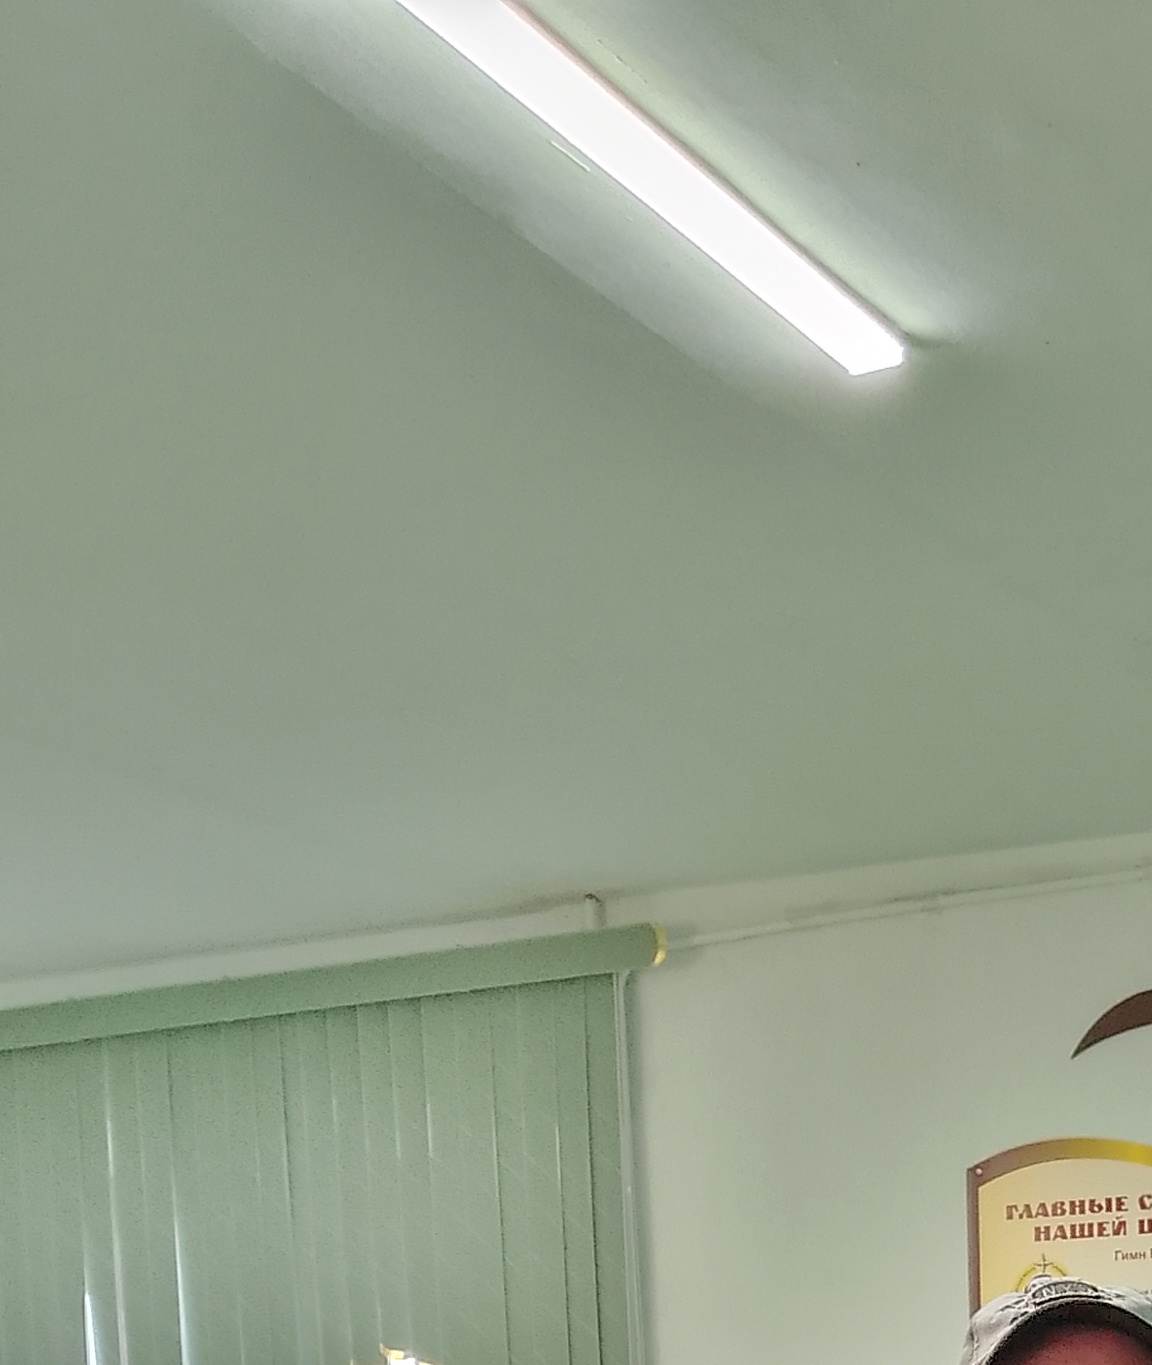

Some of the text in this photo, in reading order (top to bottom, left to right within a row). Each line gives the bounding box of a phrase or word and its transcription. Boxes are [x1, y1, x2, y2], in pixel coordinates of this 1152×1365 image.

[1006, 1195, 1129, 1220] ГЛАВНЫЕ
[1034, 1215, 1128, 1243] НАШЕЙ
[1114, 1249, 1147, 1261] Гимн
